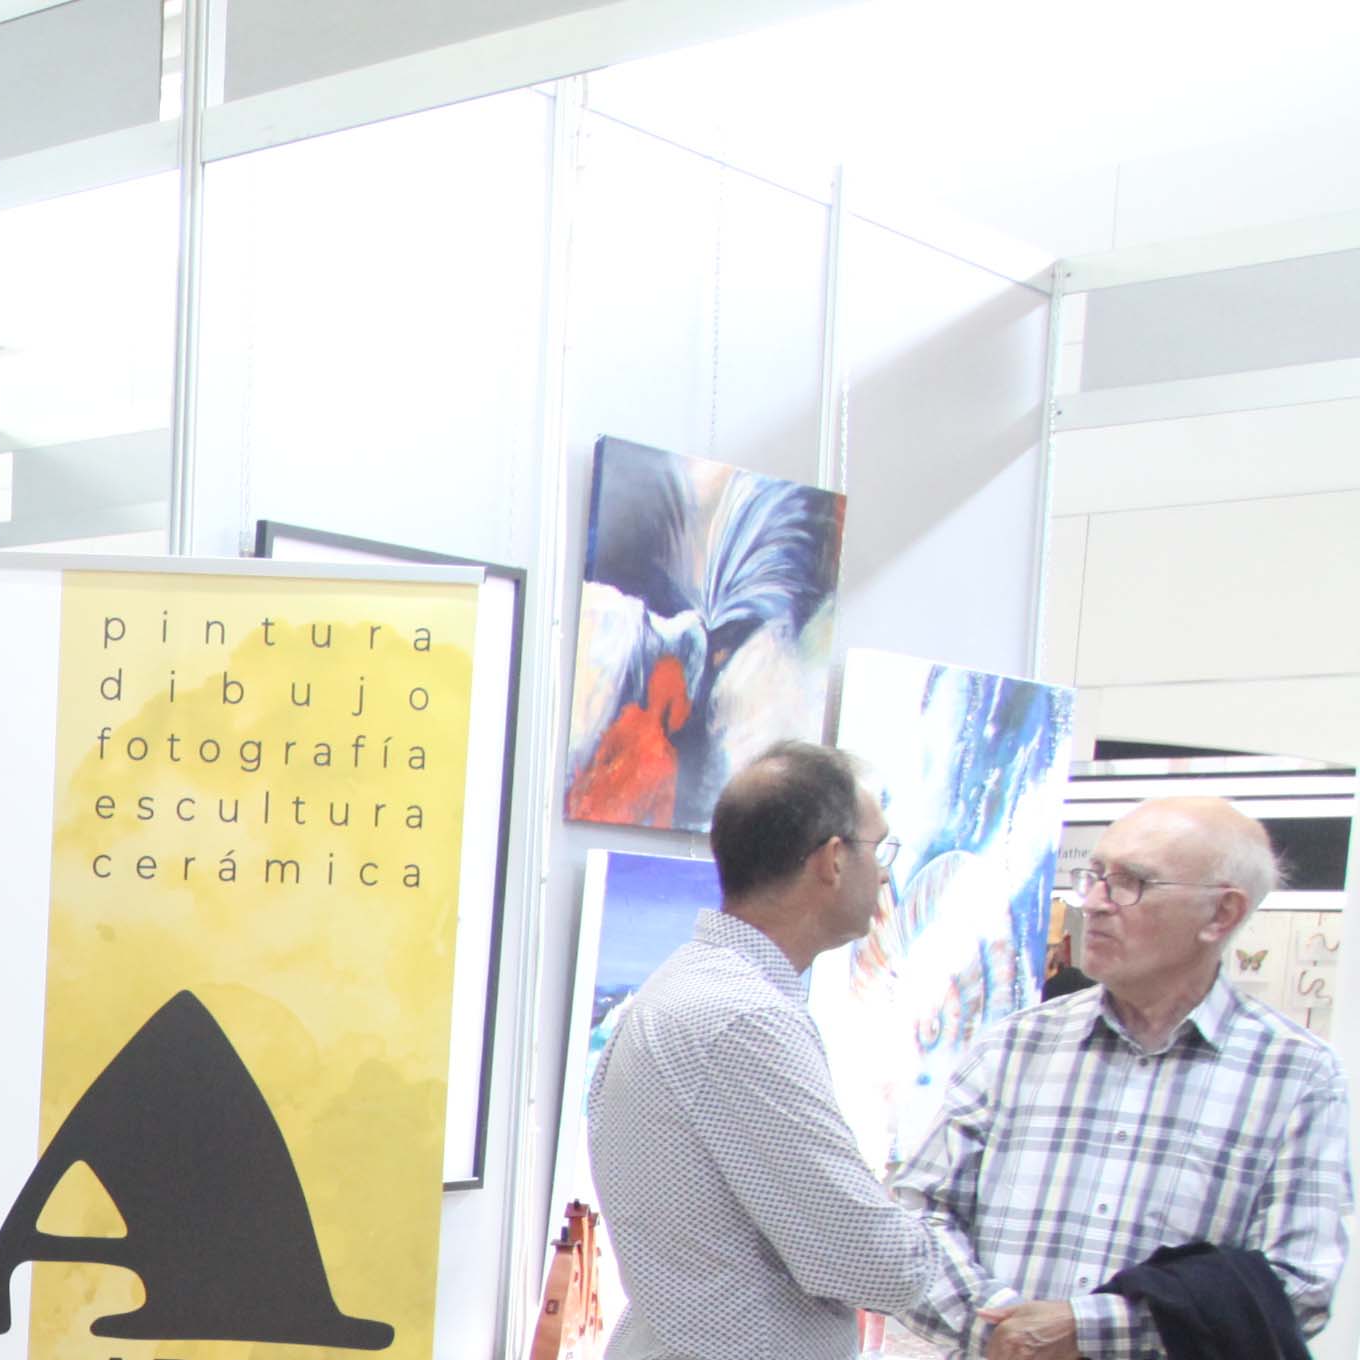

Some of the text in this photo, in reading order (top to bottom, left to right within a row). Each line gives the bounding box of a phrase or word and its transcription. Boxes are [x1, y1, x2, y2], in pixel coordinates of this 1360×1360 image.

[103, 609, 432, 652] pintura
[99, 667, 430, 717] dibujo
[96, 727, 427, 773] fotografía
[94, 790, 424, 829] escultura
[92, 849, 421, 888] cerámica
